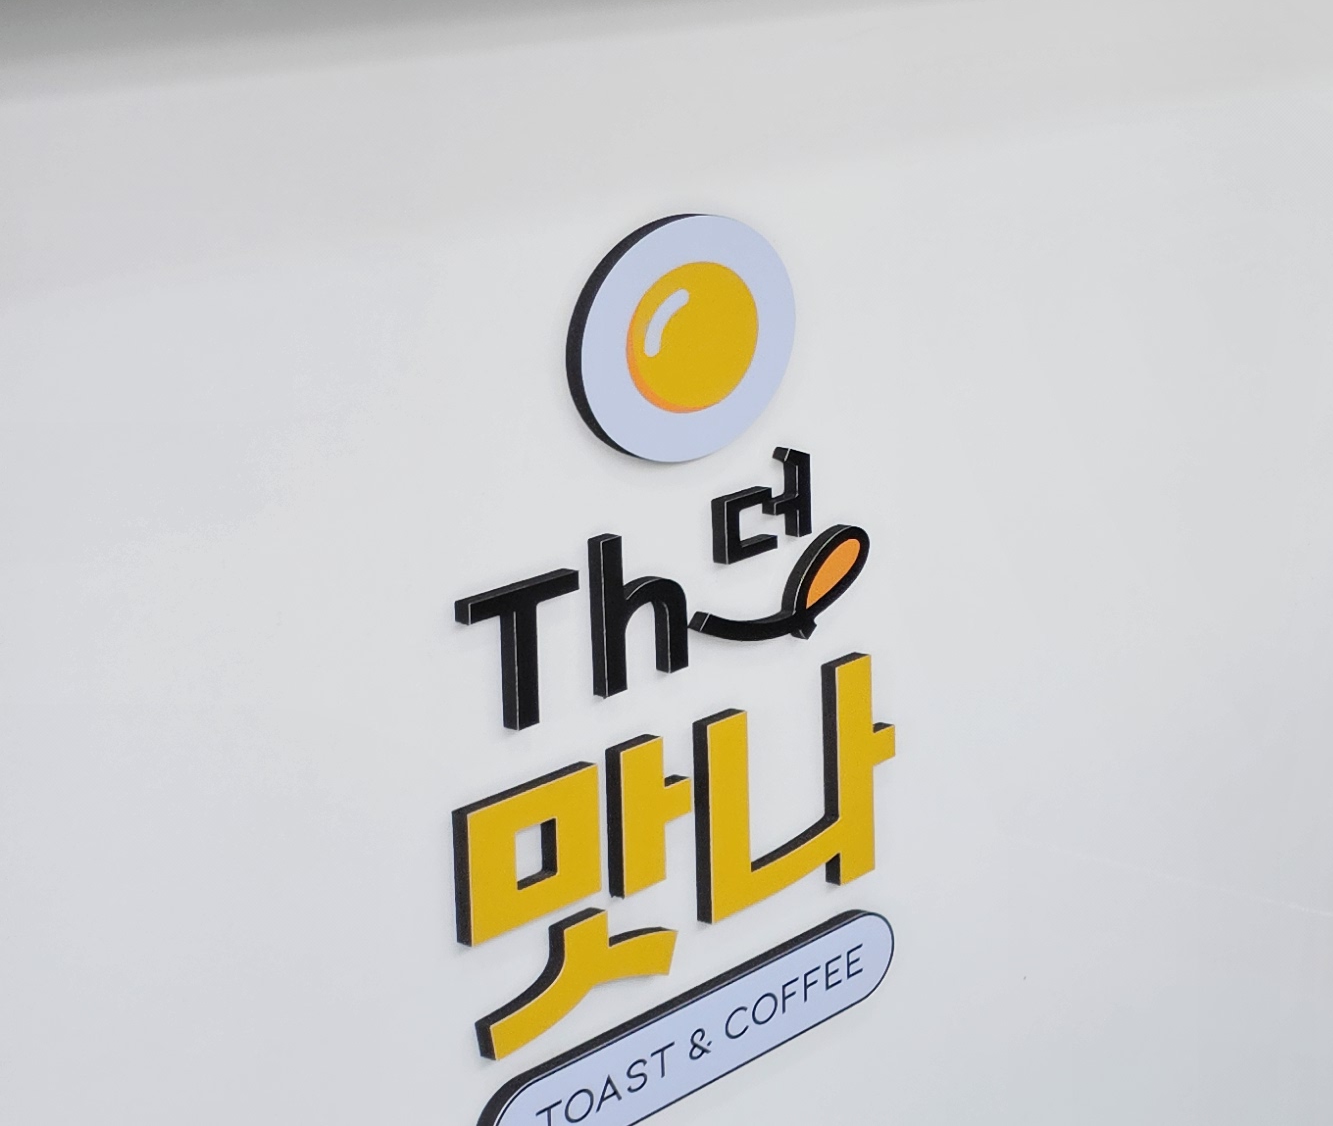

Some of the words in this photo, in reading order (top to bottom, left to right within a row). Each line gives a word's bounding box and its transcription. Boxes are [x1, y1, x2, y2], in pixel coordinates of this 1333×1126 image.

[451, 651, 896, 1061] 맛나
[536, 1042, 675, 1126] TOAST
[688, 1028, 712, 1061] &
[724, 943, 864, 1040] COFFEE
